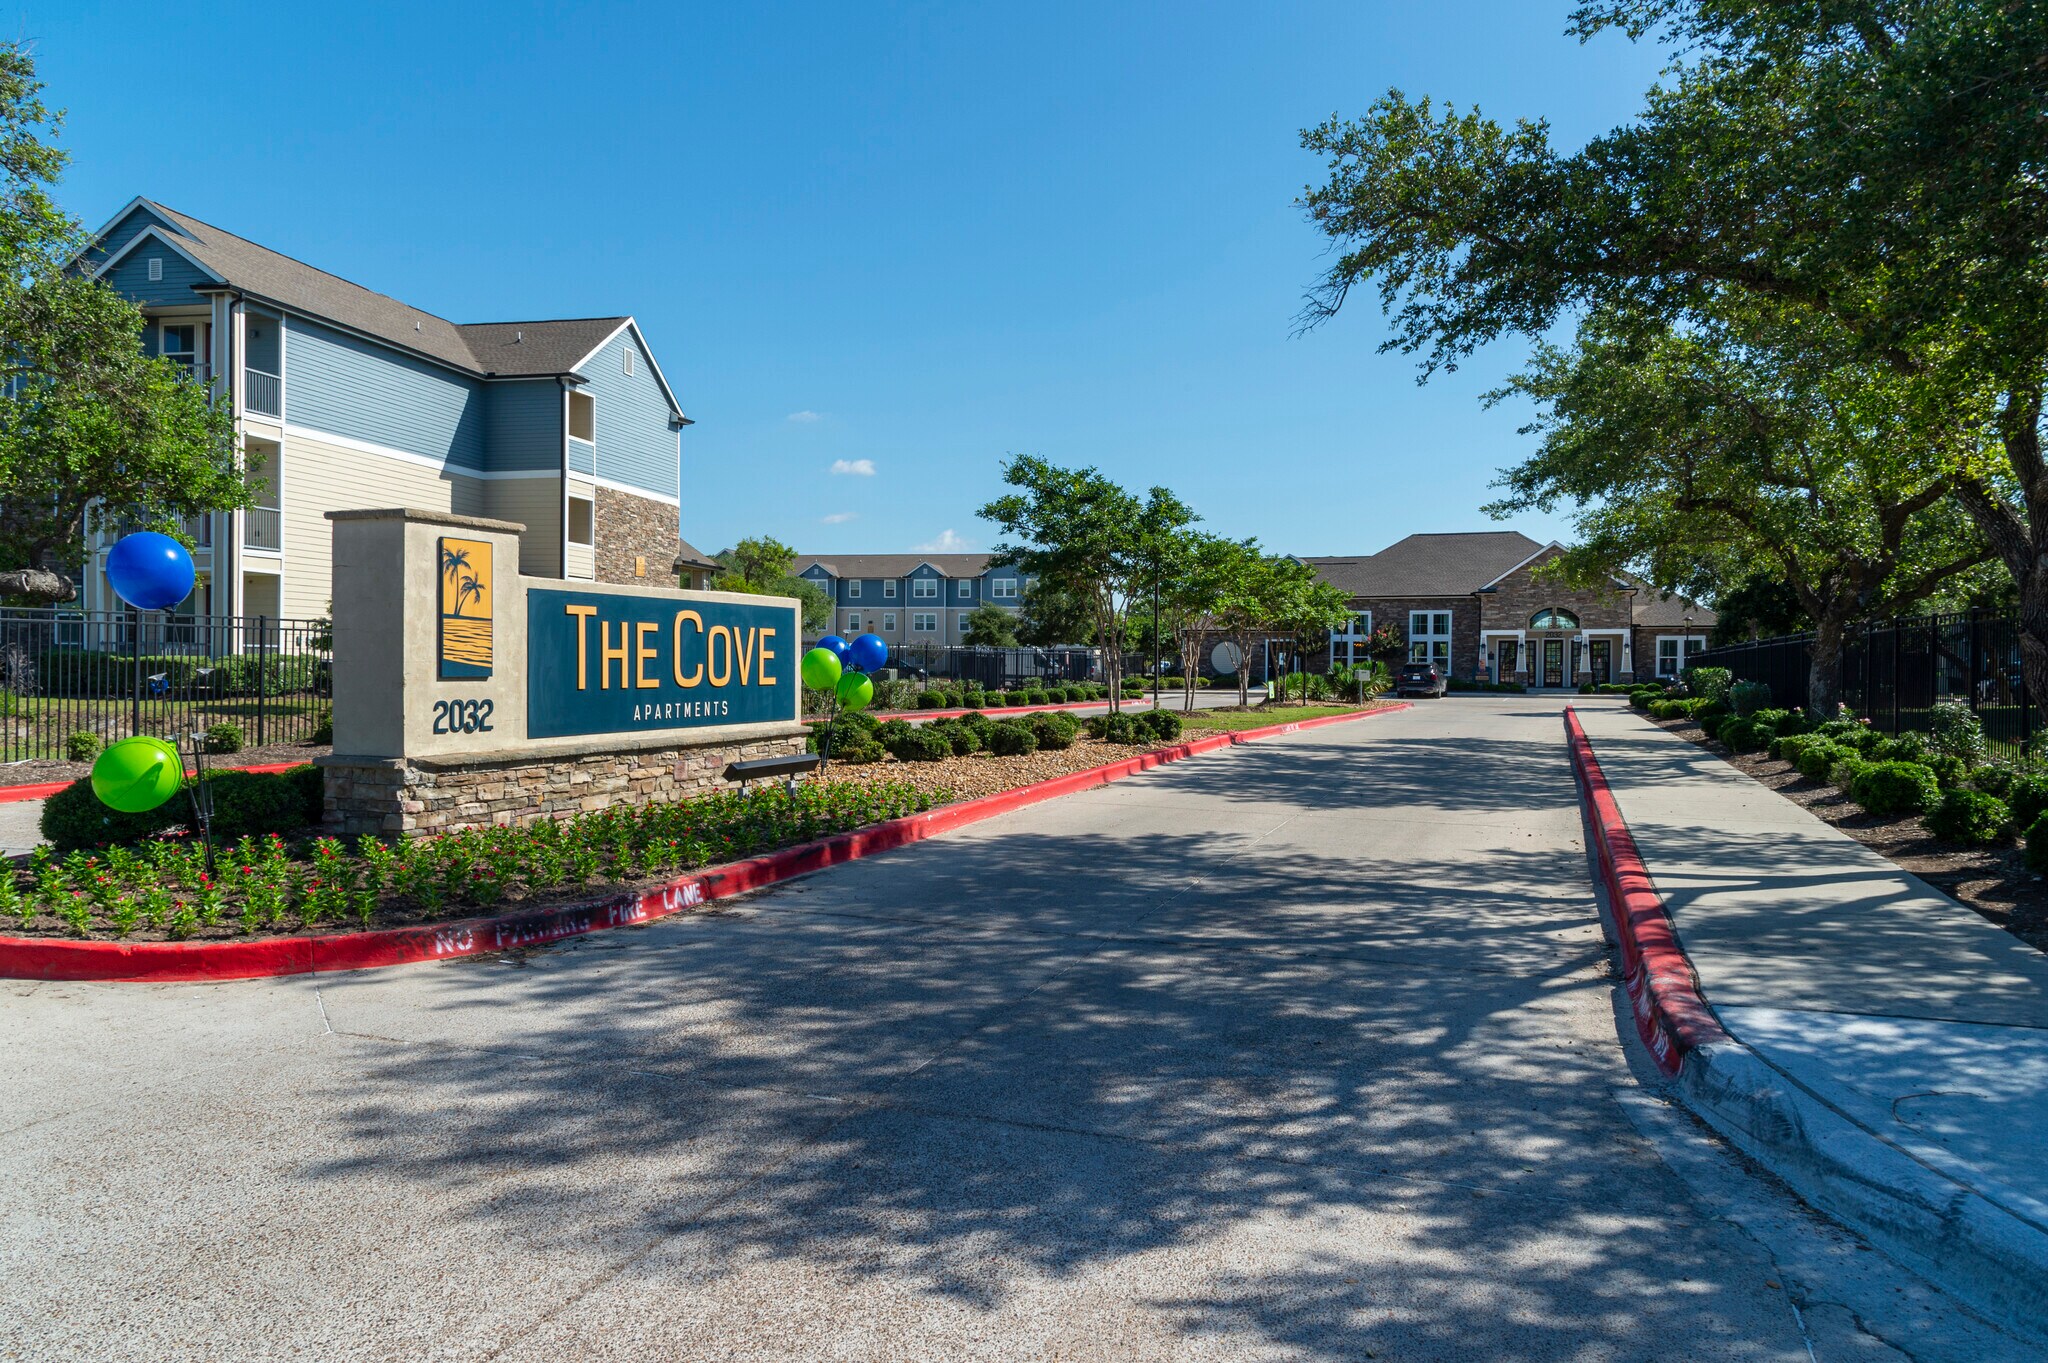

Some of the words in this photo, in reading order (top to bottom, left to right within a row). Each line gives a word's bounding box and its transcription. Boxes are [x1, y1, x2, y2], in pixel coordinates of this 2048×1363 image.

[565, 604, 660, 690] THE
[673, 609, 777, 688] COVE
[432, 698, 494, 735] 2032
[633, 700, 729, 721] APARTMENTS
[435, 928, 474, 954] NO
[608, 896, 647, 925] FIRE
[662, 882, 704, 911] LANE
